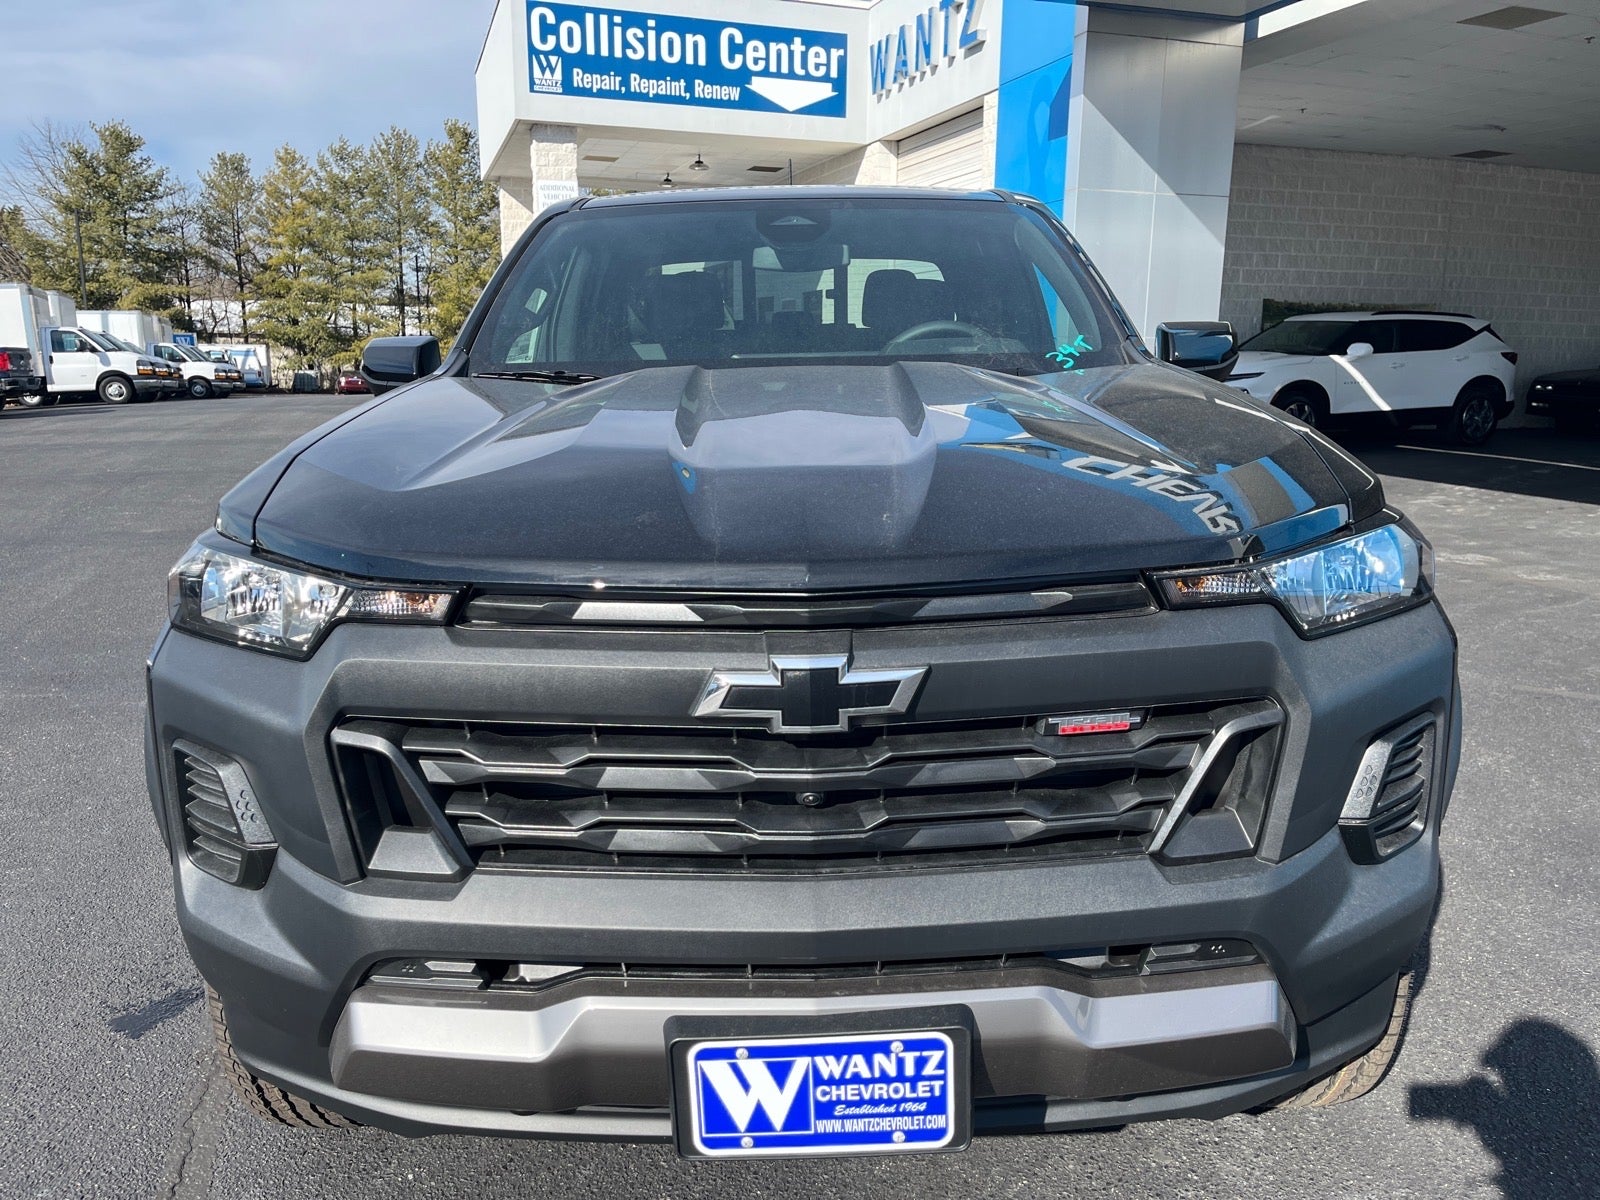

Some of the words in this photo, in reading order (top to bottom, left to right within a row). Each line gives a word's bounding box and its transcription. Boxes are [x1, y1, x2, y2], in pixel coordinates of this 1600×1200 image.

[530, 6, 707, 67] Collision
[720, 26, 845, 79] Center
[869, 0, 985, 96] WANTZ
[534, 78, 562, 88] WANTZ
[572, 67, 626, 94] Repair,
[630, 72, 691, 100] Repaint,
[694, 79, 741, 102] Renew
[814, 1050, 945, 1080] WANTZ
[816, 1080, 944, 1102] CHEVROLET
[834, 1103, 897, 1116] Established
[899, 1101, 928, 1113] 1964
[816, 1114, 946, 1133] WWW.WANTZCHEVROLET.COM
